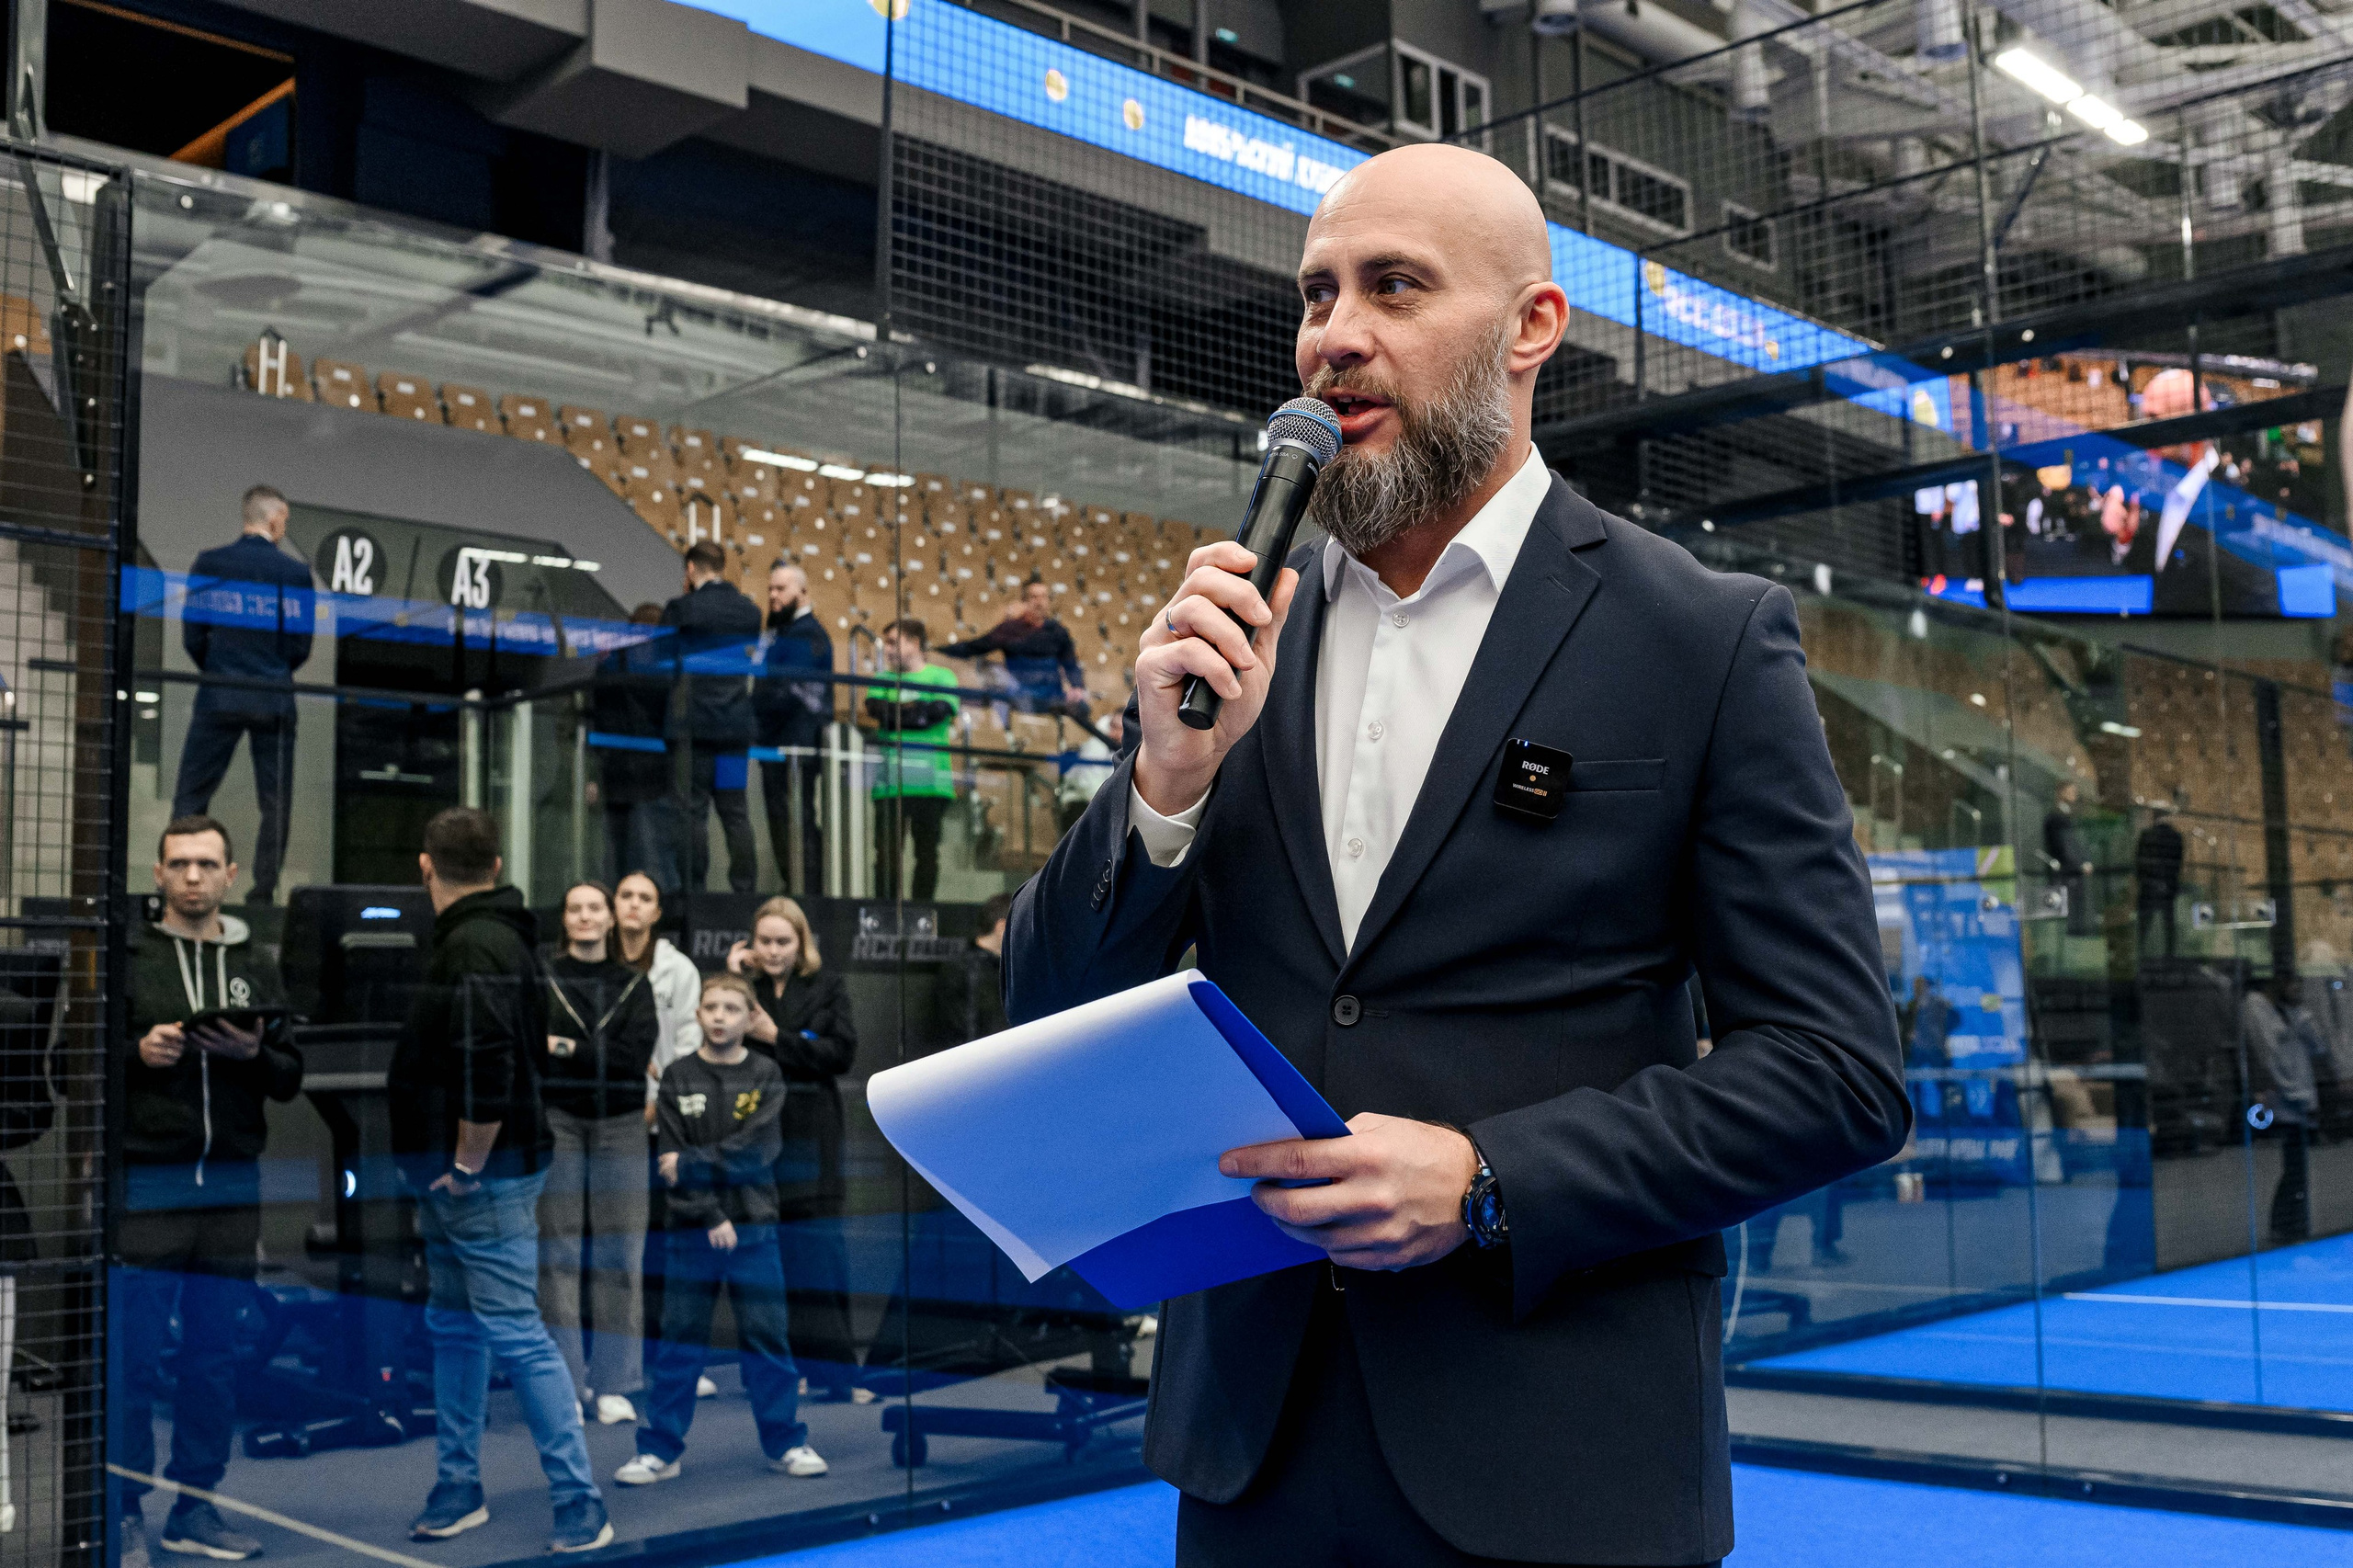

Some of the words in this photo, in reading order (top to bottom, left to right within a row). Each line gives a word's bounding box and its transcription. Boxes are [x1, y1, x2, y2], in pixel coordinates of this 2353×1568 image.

[331, 535, 374, 596] A2
[450, 546, 491, 609] A3
[1521, 760, 1550, 776] RØDE
[1512, 782, 1535, 794] WIRELESS
